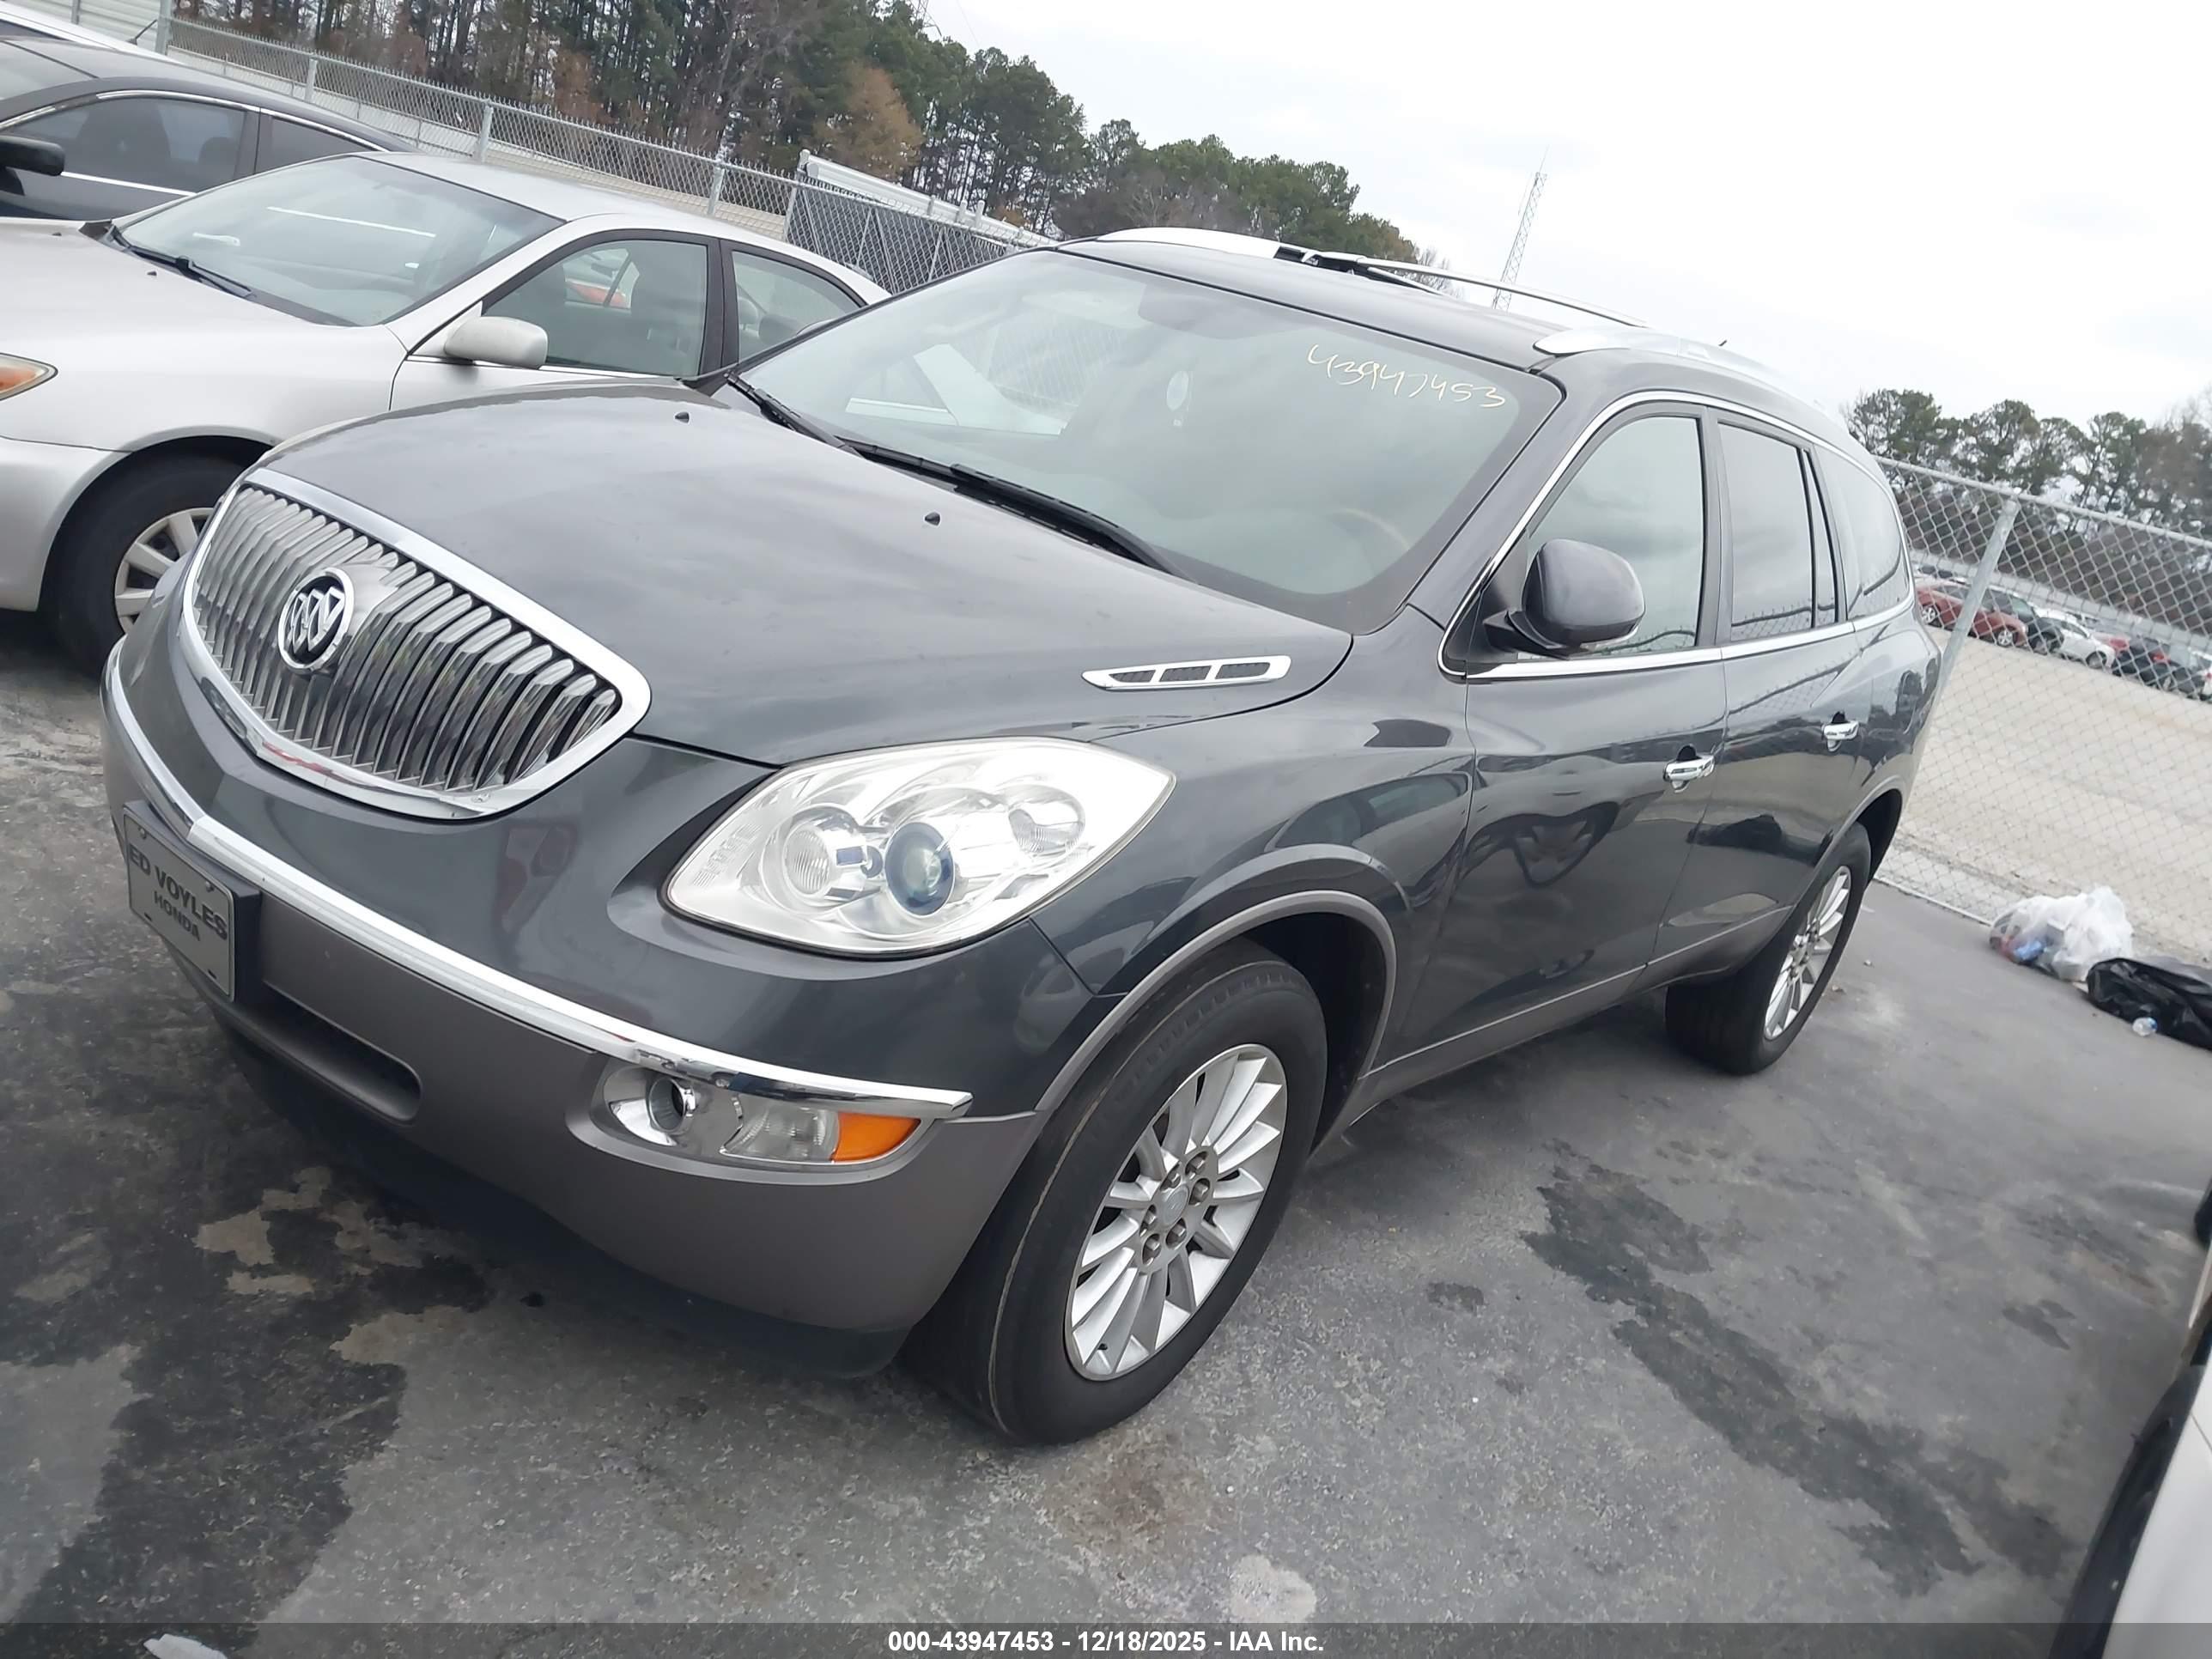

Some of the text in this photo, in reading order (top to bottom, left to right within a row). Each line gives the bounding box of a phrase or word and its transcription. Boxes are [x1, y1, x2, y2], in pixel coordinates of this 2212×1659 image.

[1307, 343, 1506, 409] 43947453
[129, 842, 228, 940] ED VOYLES
[154, 890, 201, 942] HONDA
